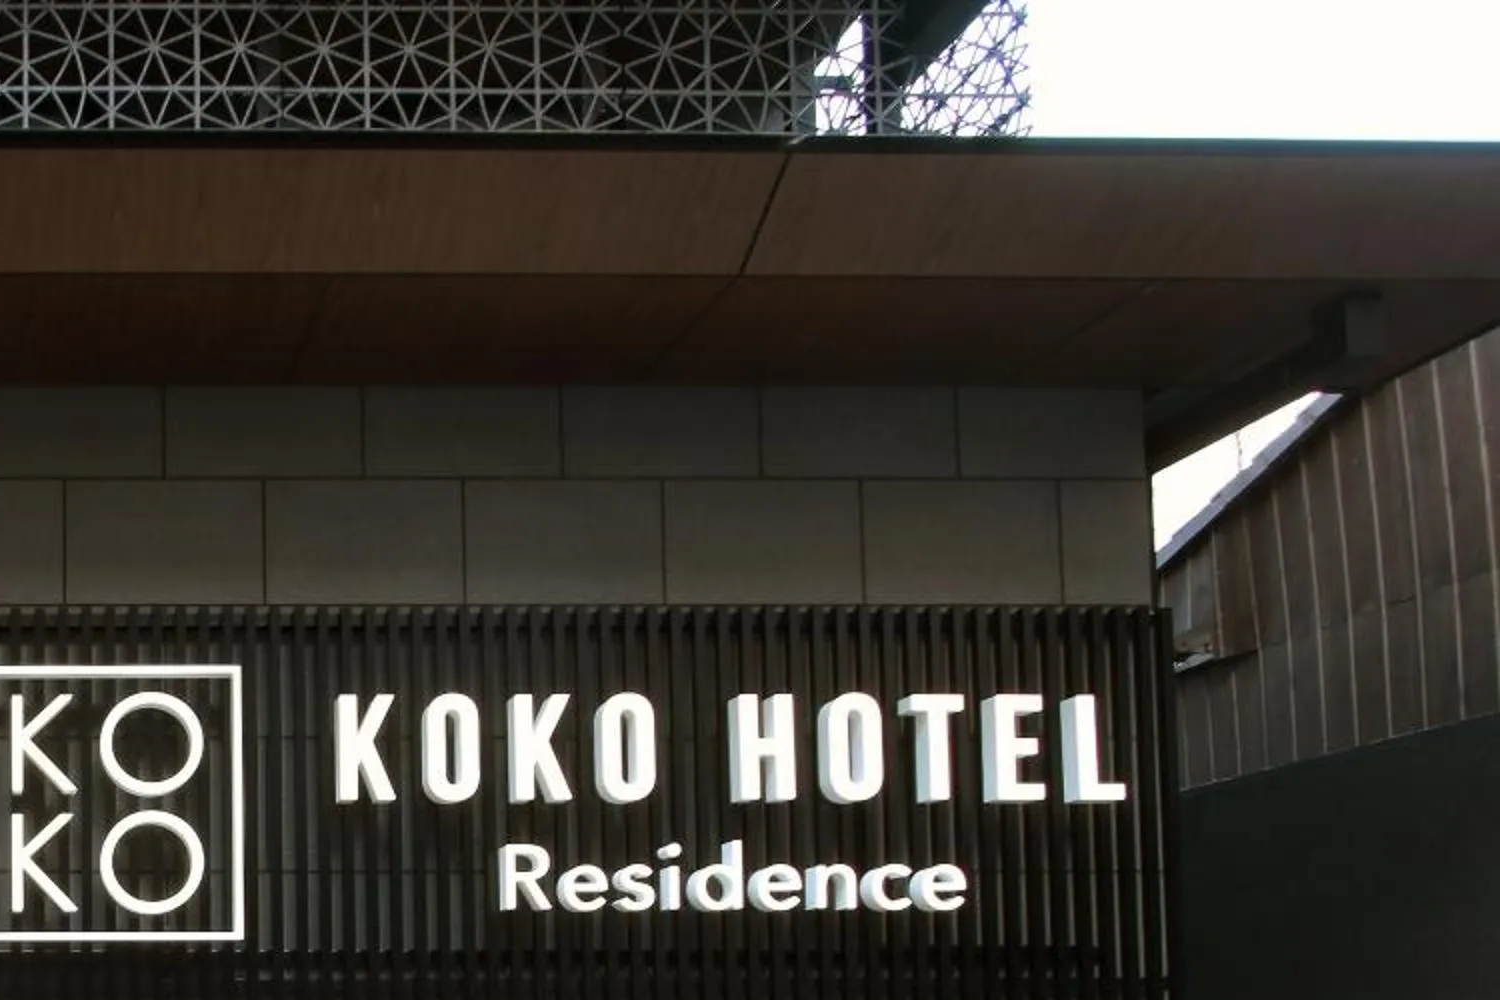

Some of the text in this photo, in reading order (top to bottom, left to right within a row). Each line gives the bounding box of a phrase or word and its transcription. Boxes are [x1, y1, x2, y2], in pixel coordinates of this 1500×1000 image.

[11, 692, 204, 797] KO
[334, 692, 1126, 804] KOKO HOTEL
[11, 810, 204, 915] KO
[498, 840, 967, 912] Residence
